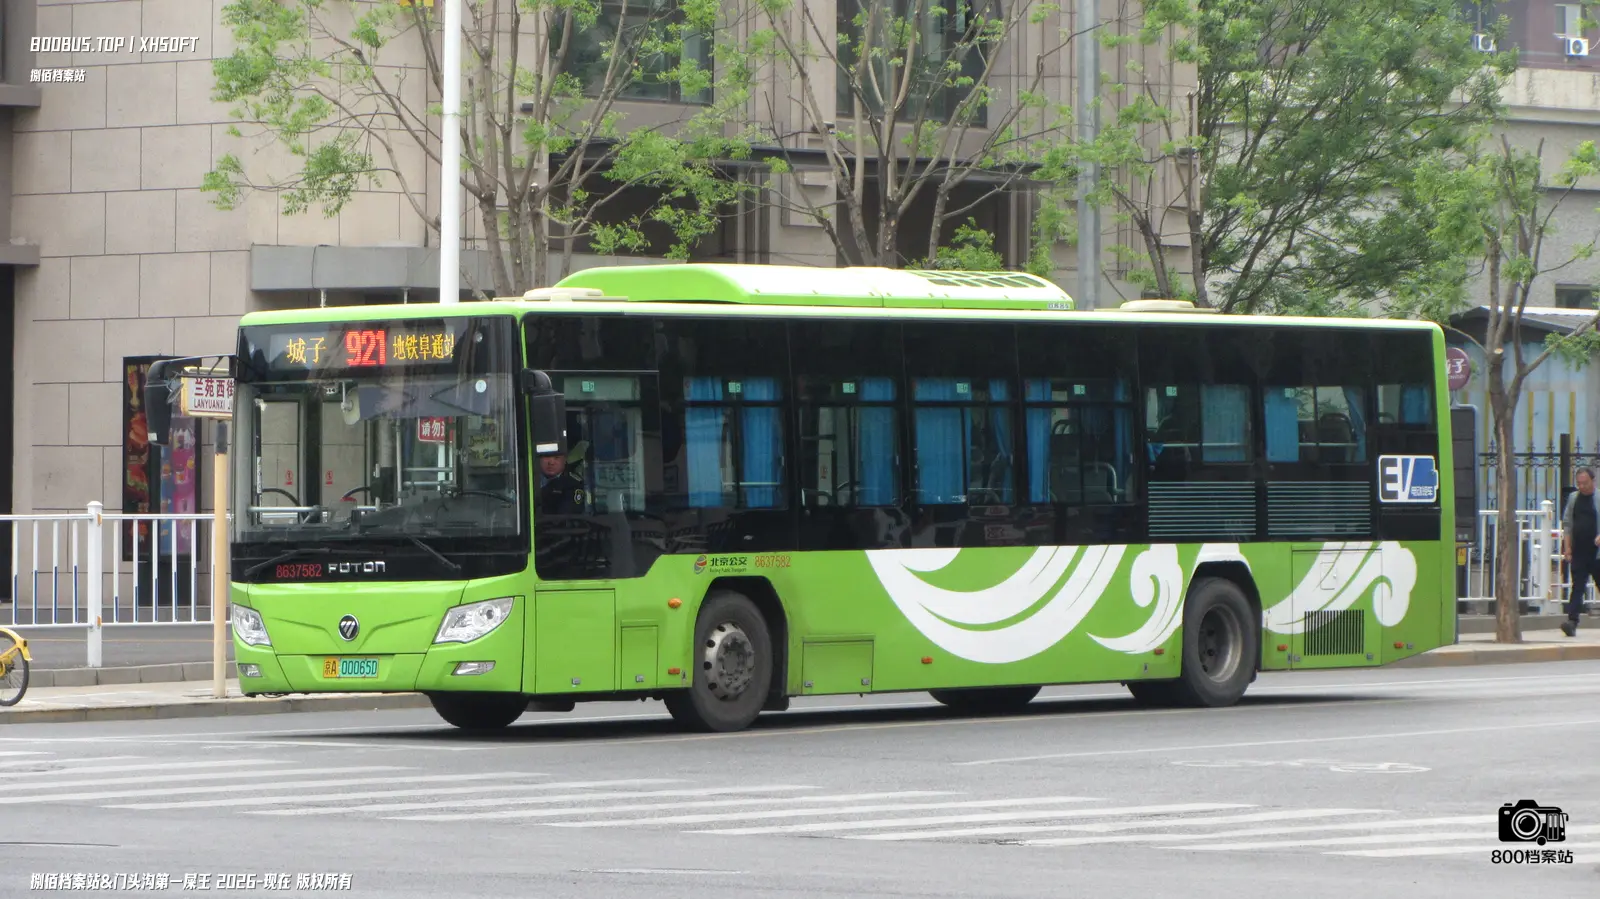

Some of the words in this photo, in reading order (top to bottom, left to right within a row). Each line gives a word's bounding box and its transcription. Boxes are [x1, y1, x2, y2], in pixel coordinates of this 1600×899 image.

[286, 336, 326, 364] 城子
[346, 330, 386, 365] 921
[328, 561, 386, 573] FOTON
[710, 557, 747, 566] 北京公交
[754, 555, 791, 568] 8637582
[276, 564, 322, 578] 8637582
